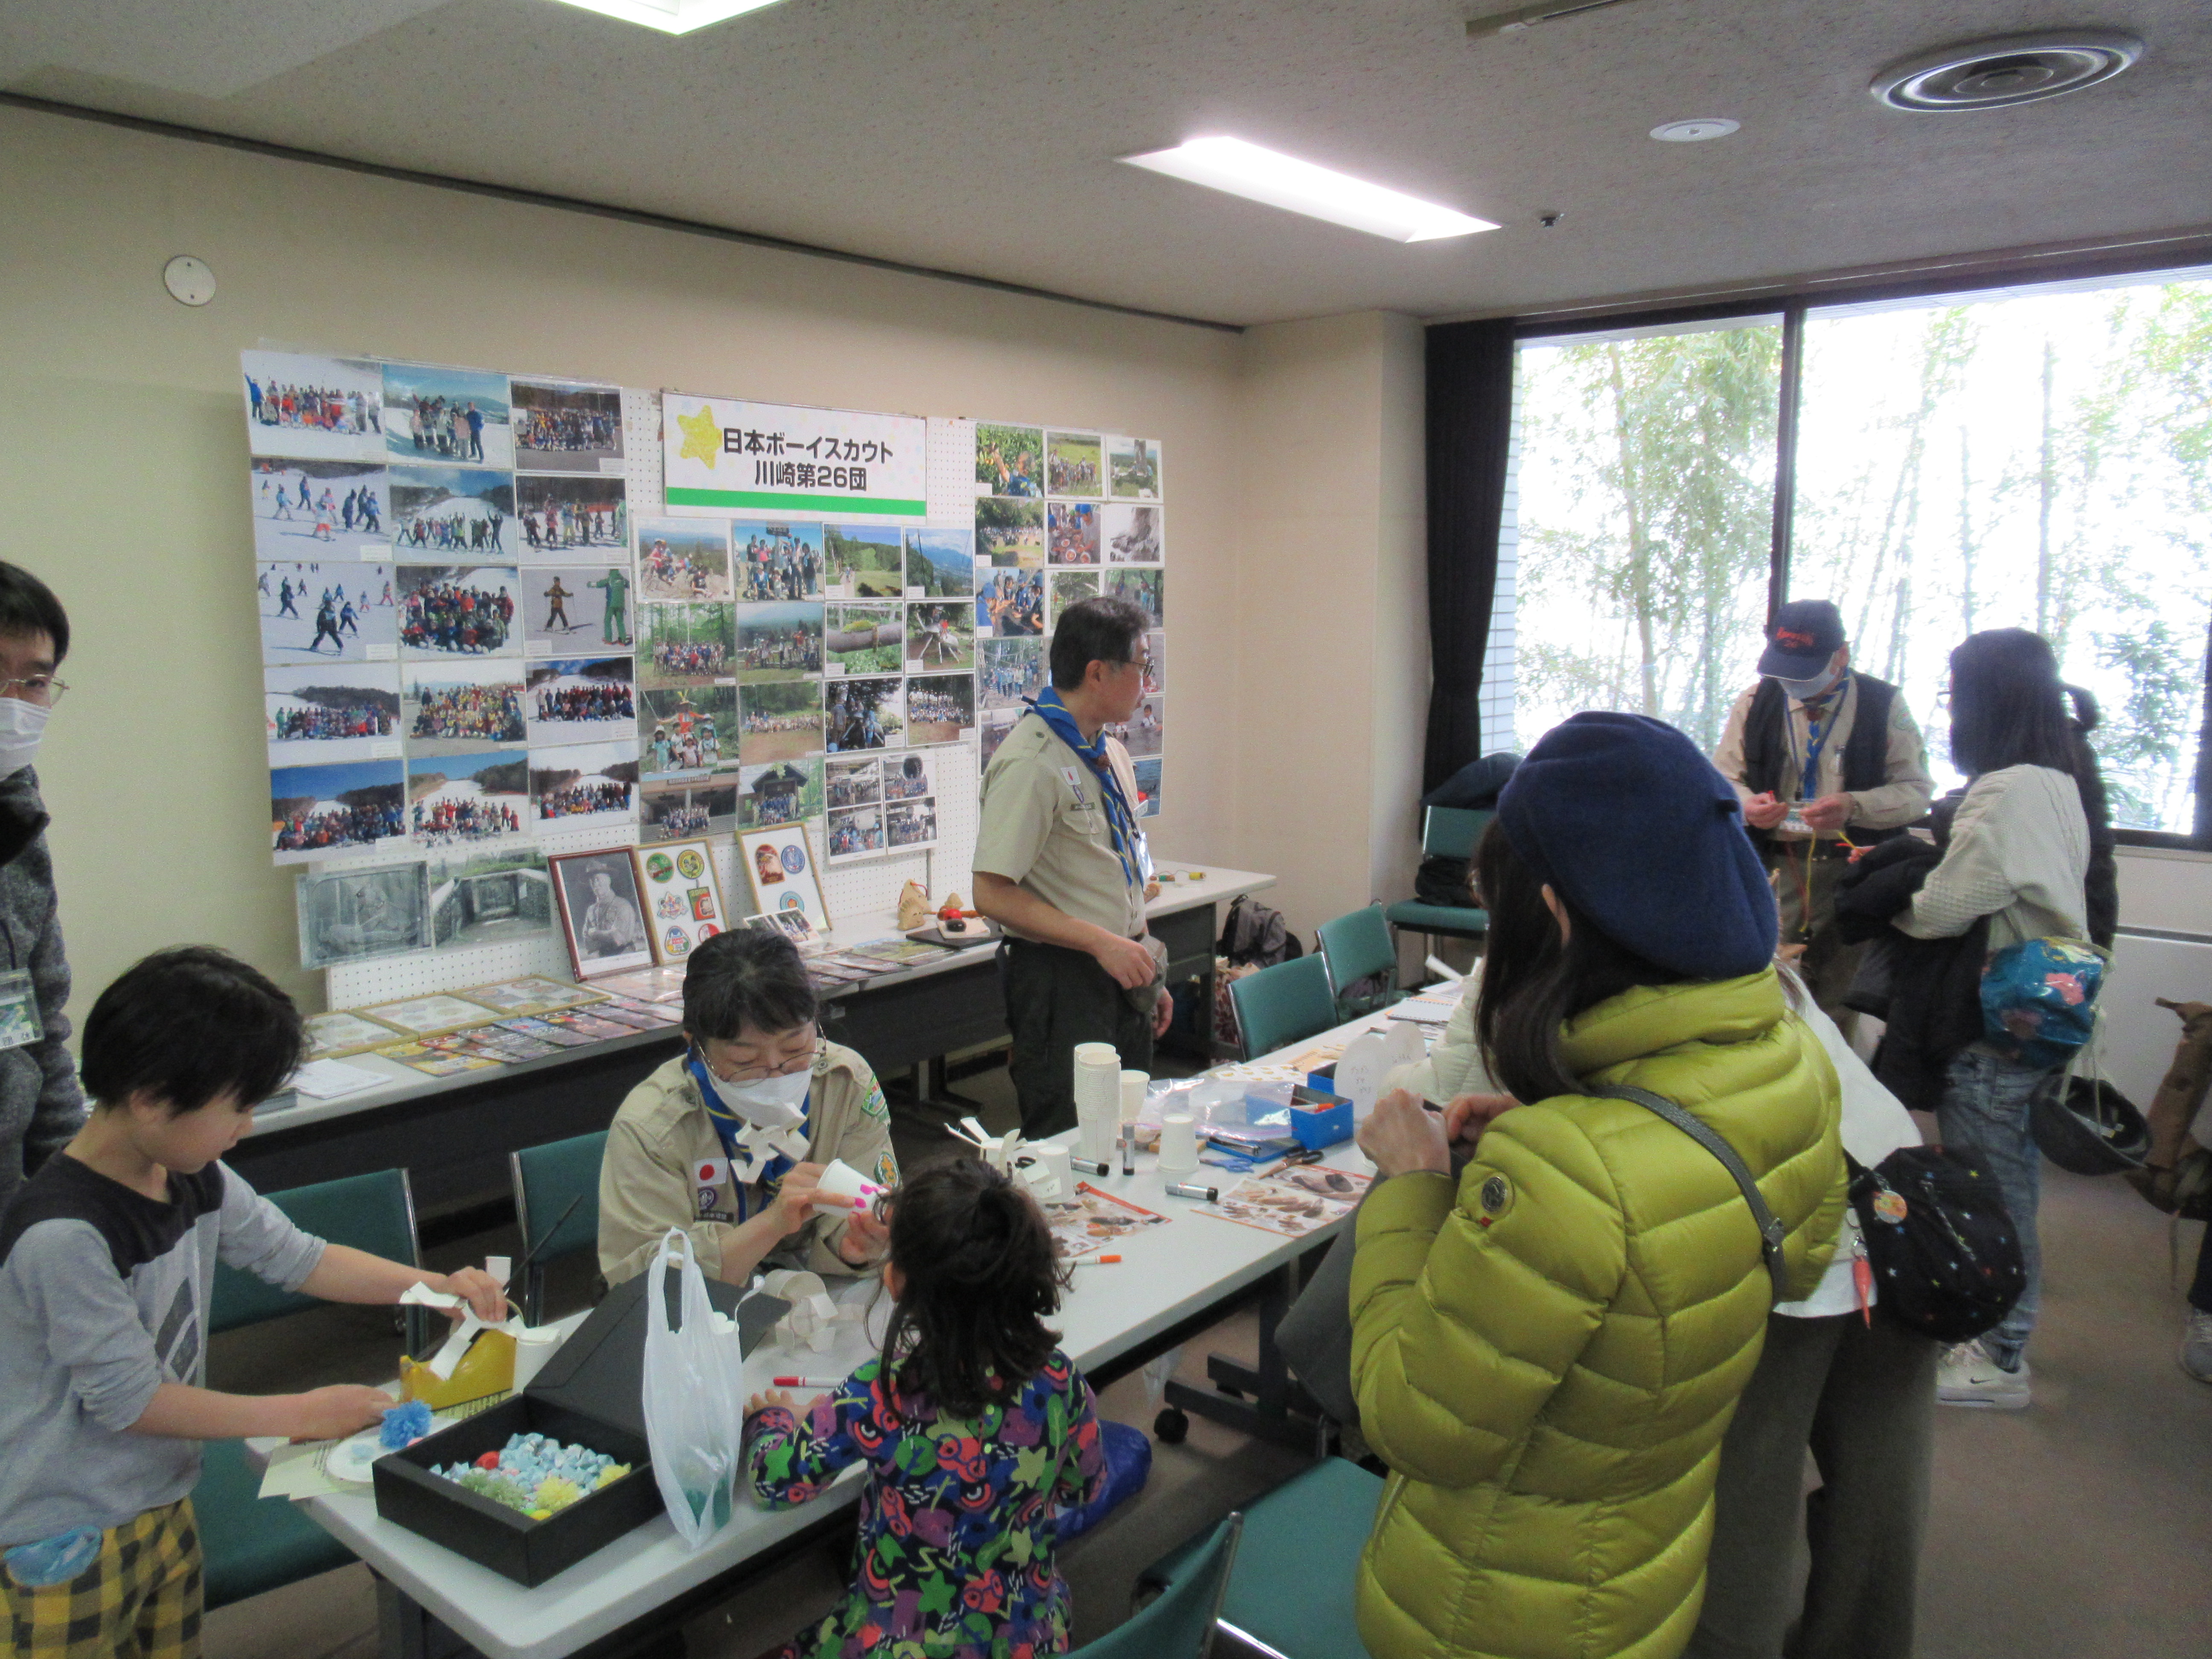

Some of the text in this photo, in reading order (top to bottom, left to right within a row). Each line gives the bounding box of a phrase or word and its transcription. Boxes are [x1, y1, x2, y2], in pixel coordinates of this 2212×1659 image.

[723, 428, 893, 464] 日本ボーイスカウト
[755, 460, 867, 491] 川崎第26団
